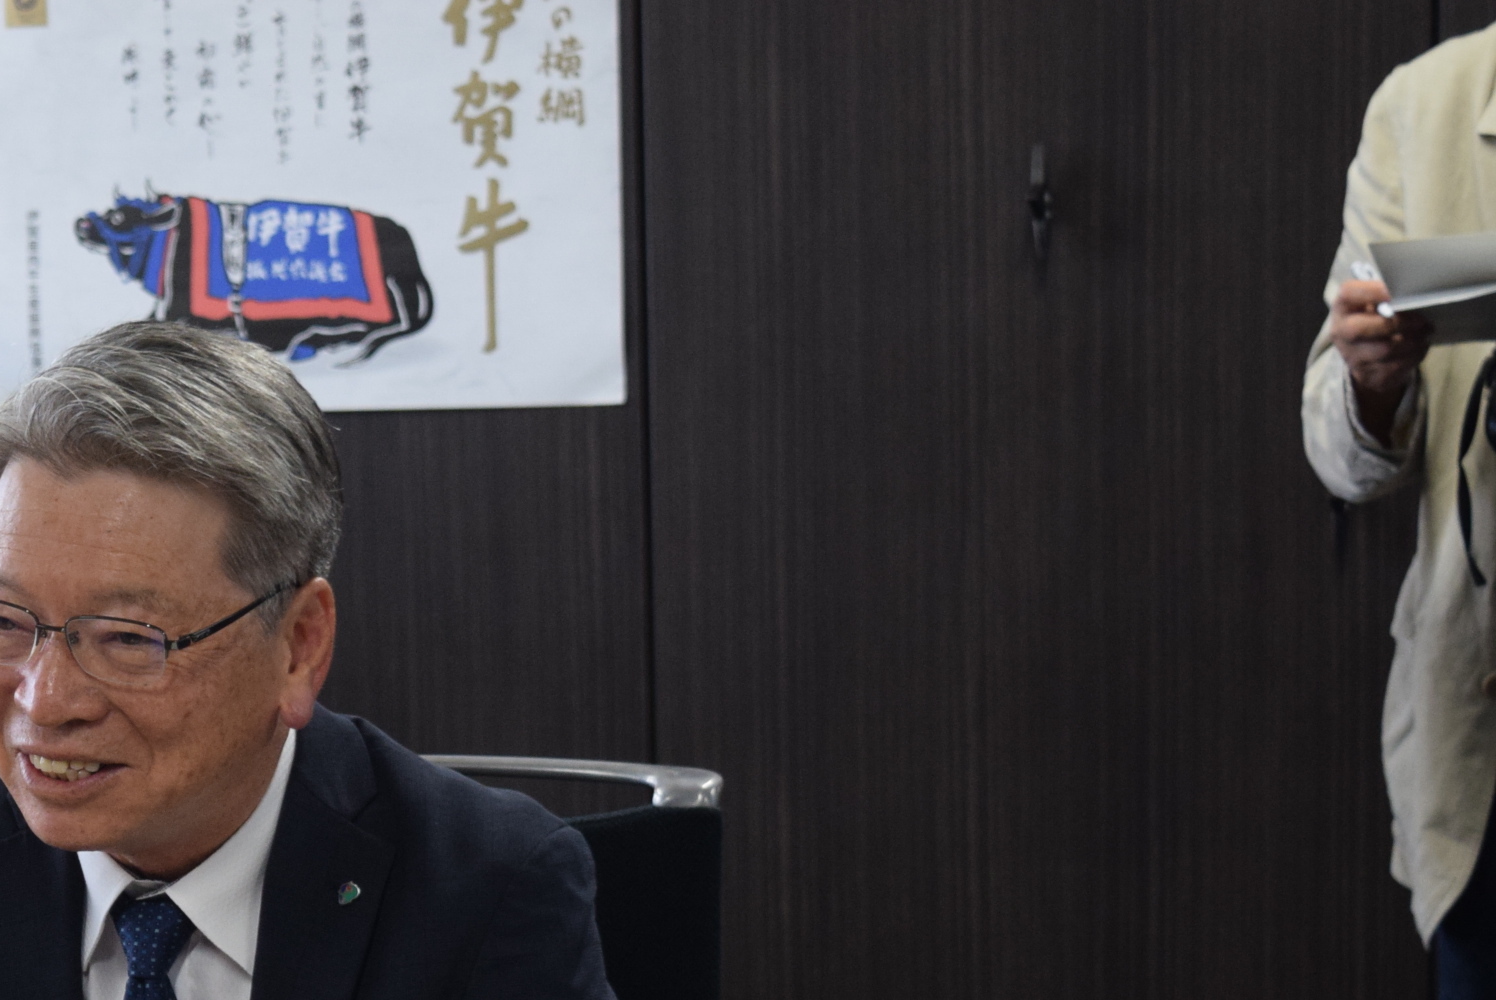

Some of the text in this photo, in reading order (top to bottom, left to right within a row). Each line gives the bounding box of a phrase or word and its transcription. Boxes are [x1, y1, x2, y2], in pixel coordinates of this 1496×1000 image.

[247, 206, 346, 258] 伊賀牛
[442, 0, 530, 354] 伊賀牛
